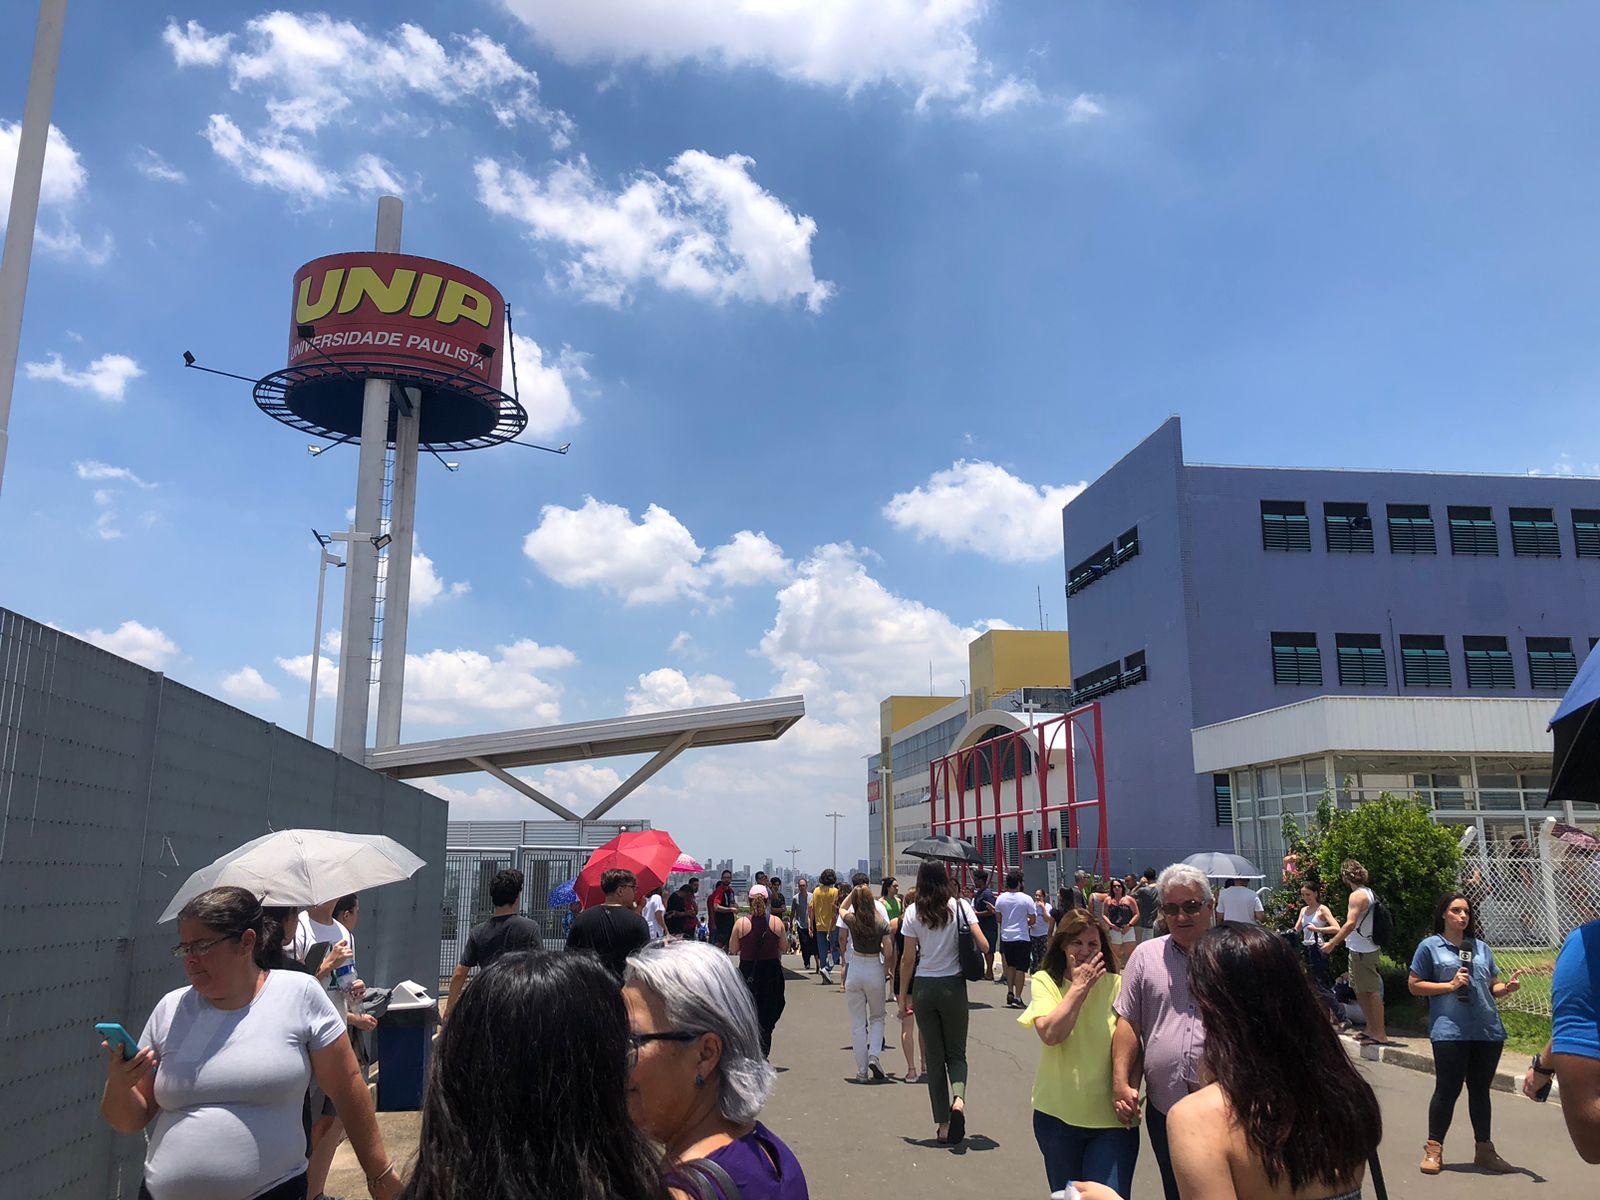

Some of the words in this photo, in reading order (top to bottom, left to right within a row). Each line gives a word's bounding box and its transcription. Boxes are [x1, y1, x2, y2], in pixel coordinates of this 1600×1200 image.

[295, 266, 493, 328] UNIP
[290, 331, 403, 360] UNIVERSIDADE
[406, 335, 484, 371] PAULISTA
